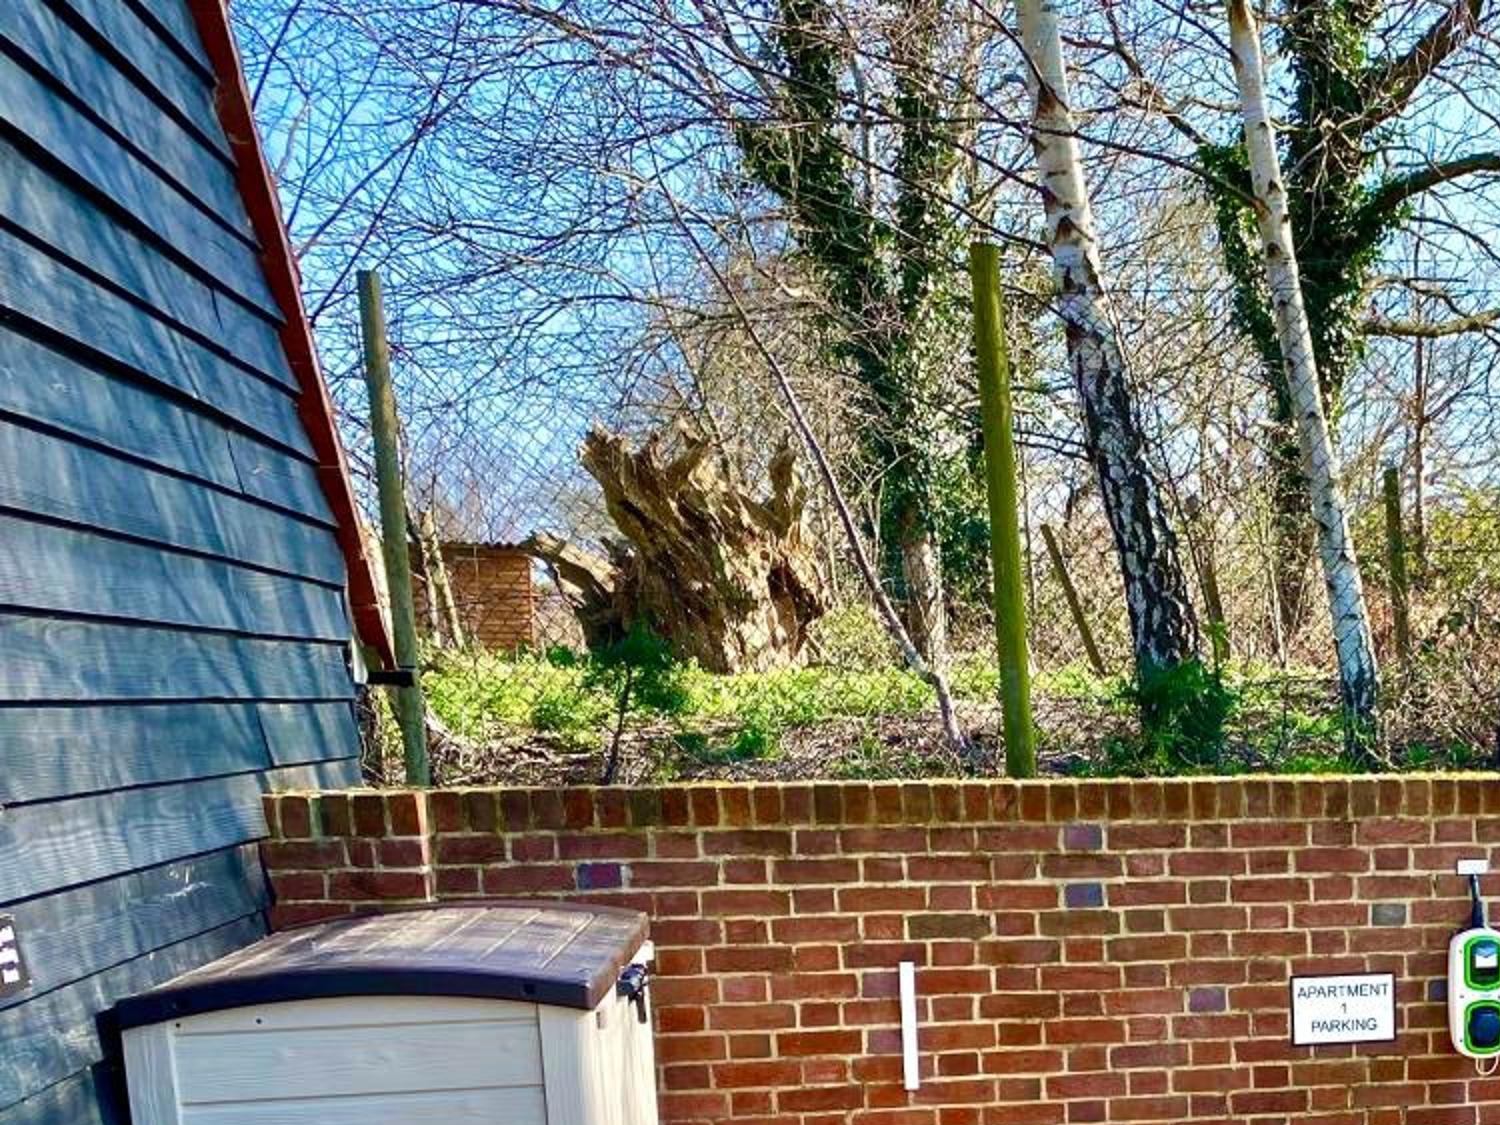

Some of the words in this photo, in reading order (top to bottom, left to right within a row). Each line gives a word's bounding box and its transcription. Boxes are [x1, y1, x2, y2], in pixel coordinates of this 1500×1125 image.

[1297, 983, 1389, 999] APARTMENT
[1341, 1001, 1348, 1014] 1
[1311, 1017, 1378, 1033] PARKING
